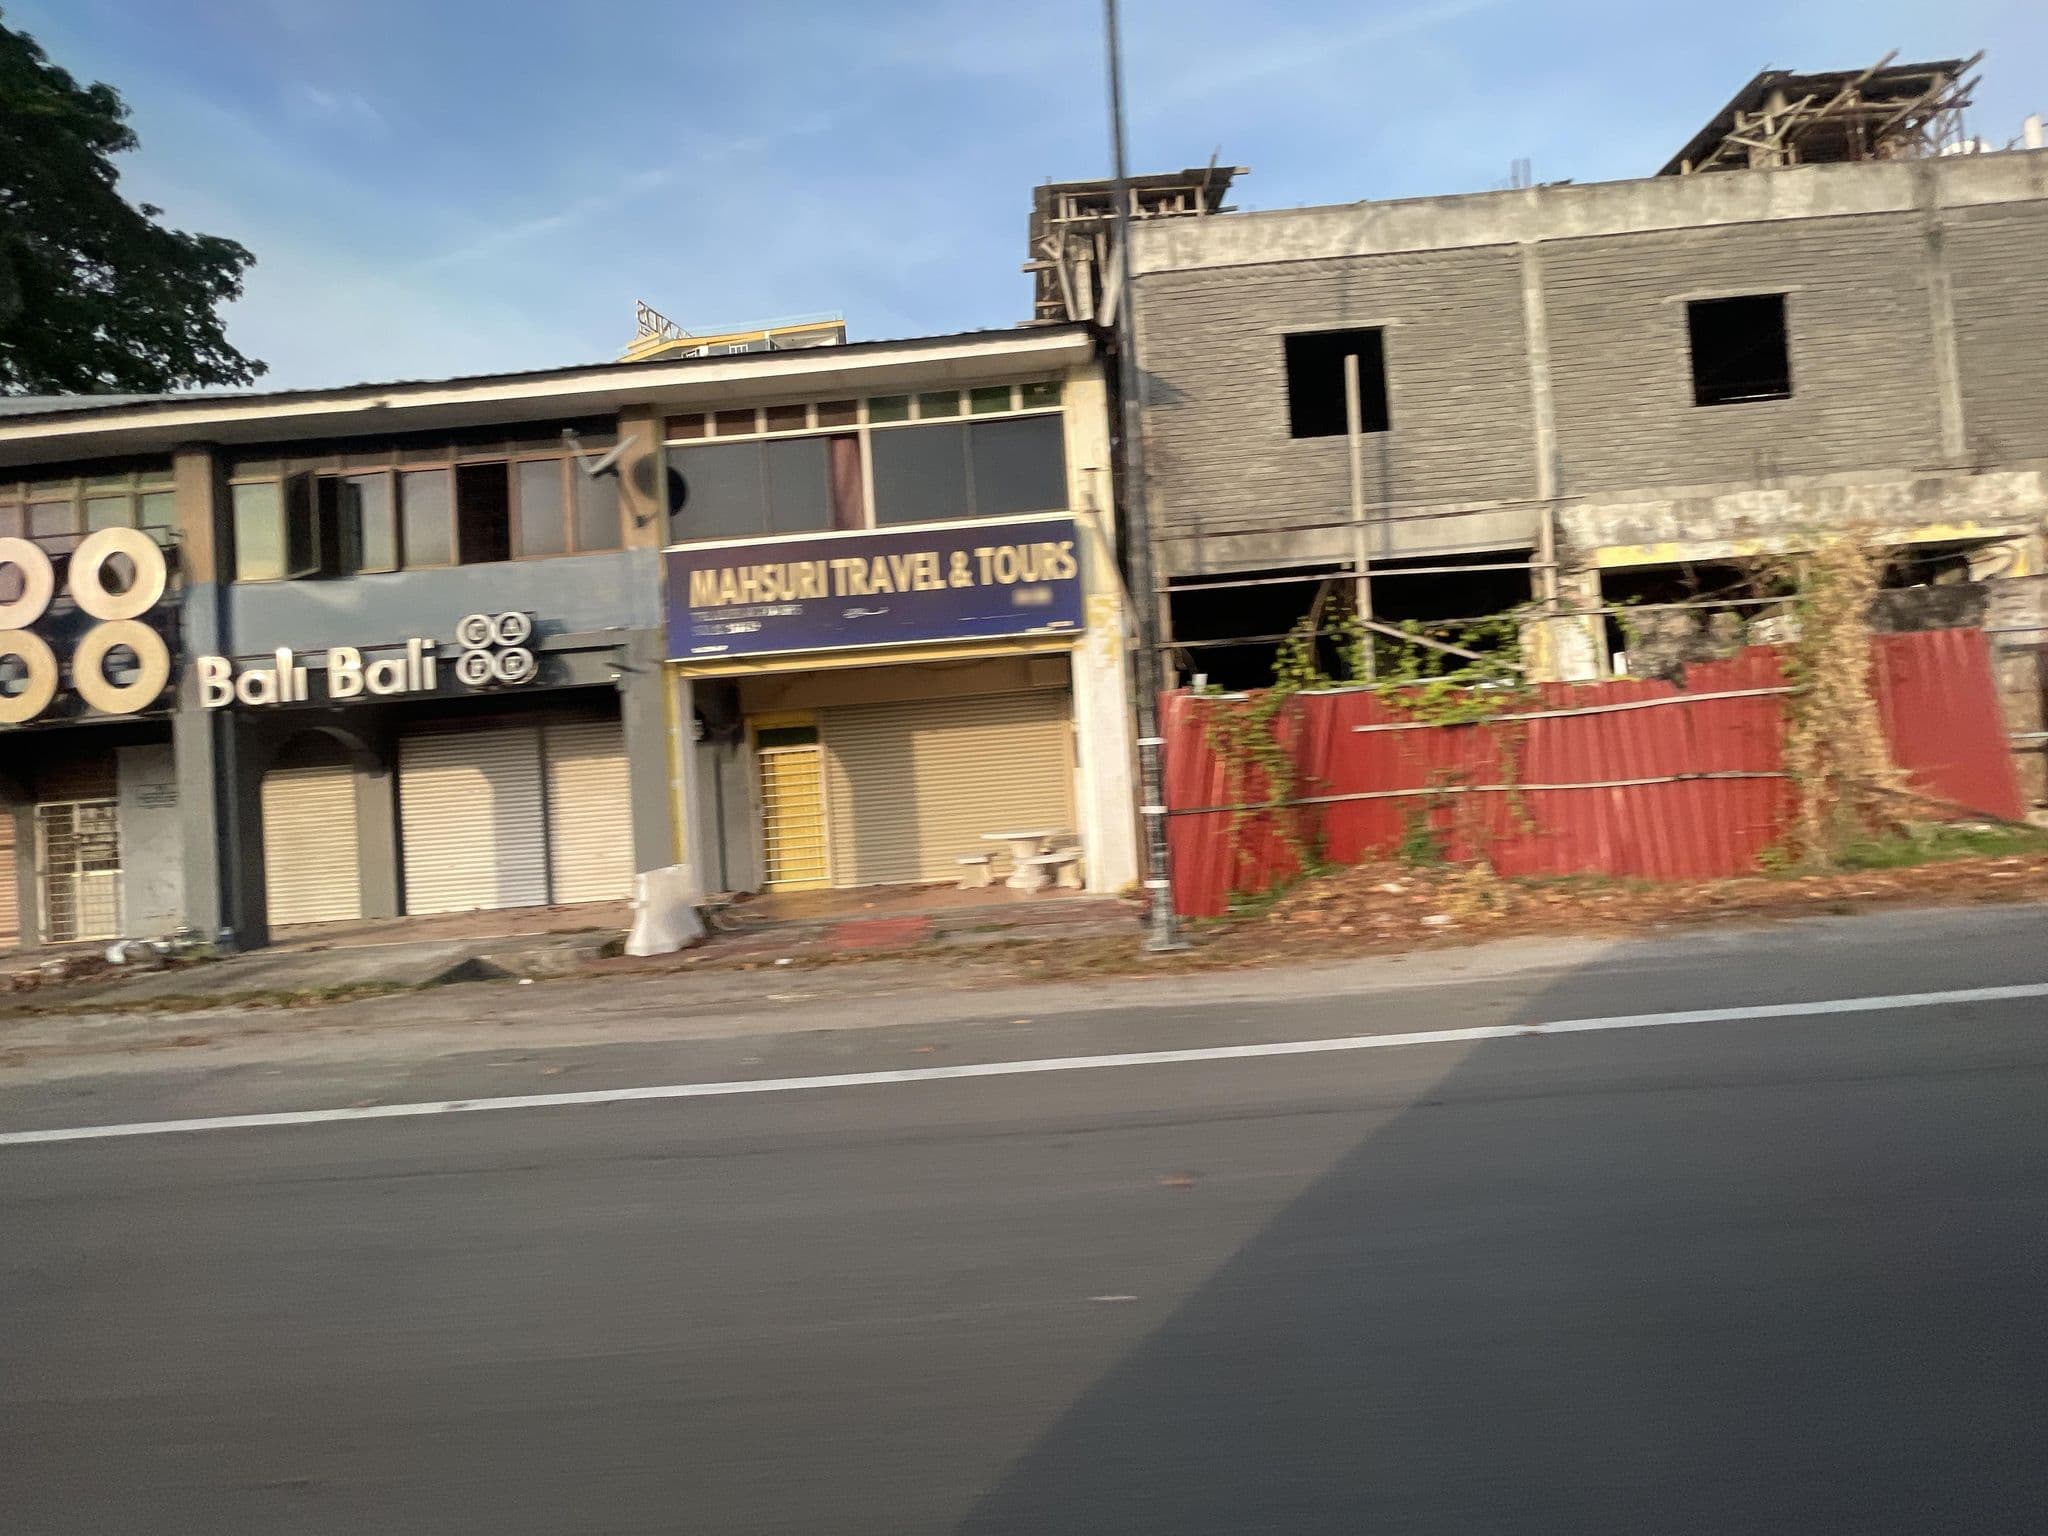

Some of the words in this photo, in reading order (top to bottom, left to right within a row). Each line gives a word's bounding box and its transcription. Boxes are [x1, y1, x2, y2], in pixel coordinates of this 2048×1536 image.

[689, 560, 829, 608] MAHSURI
[829, 551, 947, 597] TRAVEL
[948, 550, 975, 589] &
[974, 540, 1079, 586] TOURS
[197, 647, 309, 708] Bali
[327, 637, 438, 698] Bali
